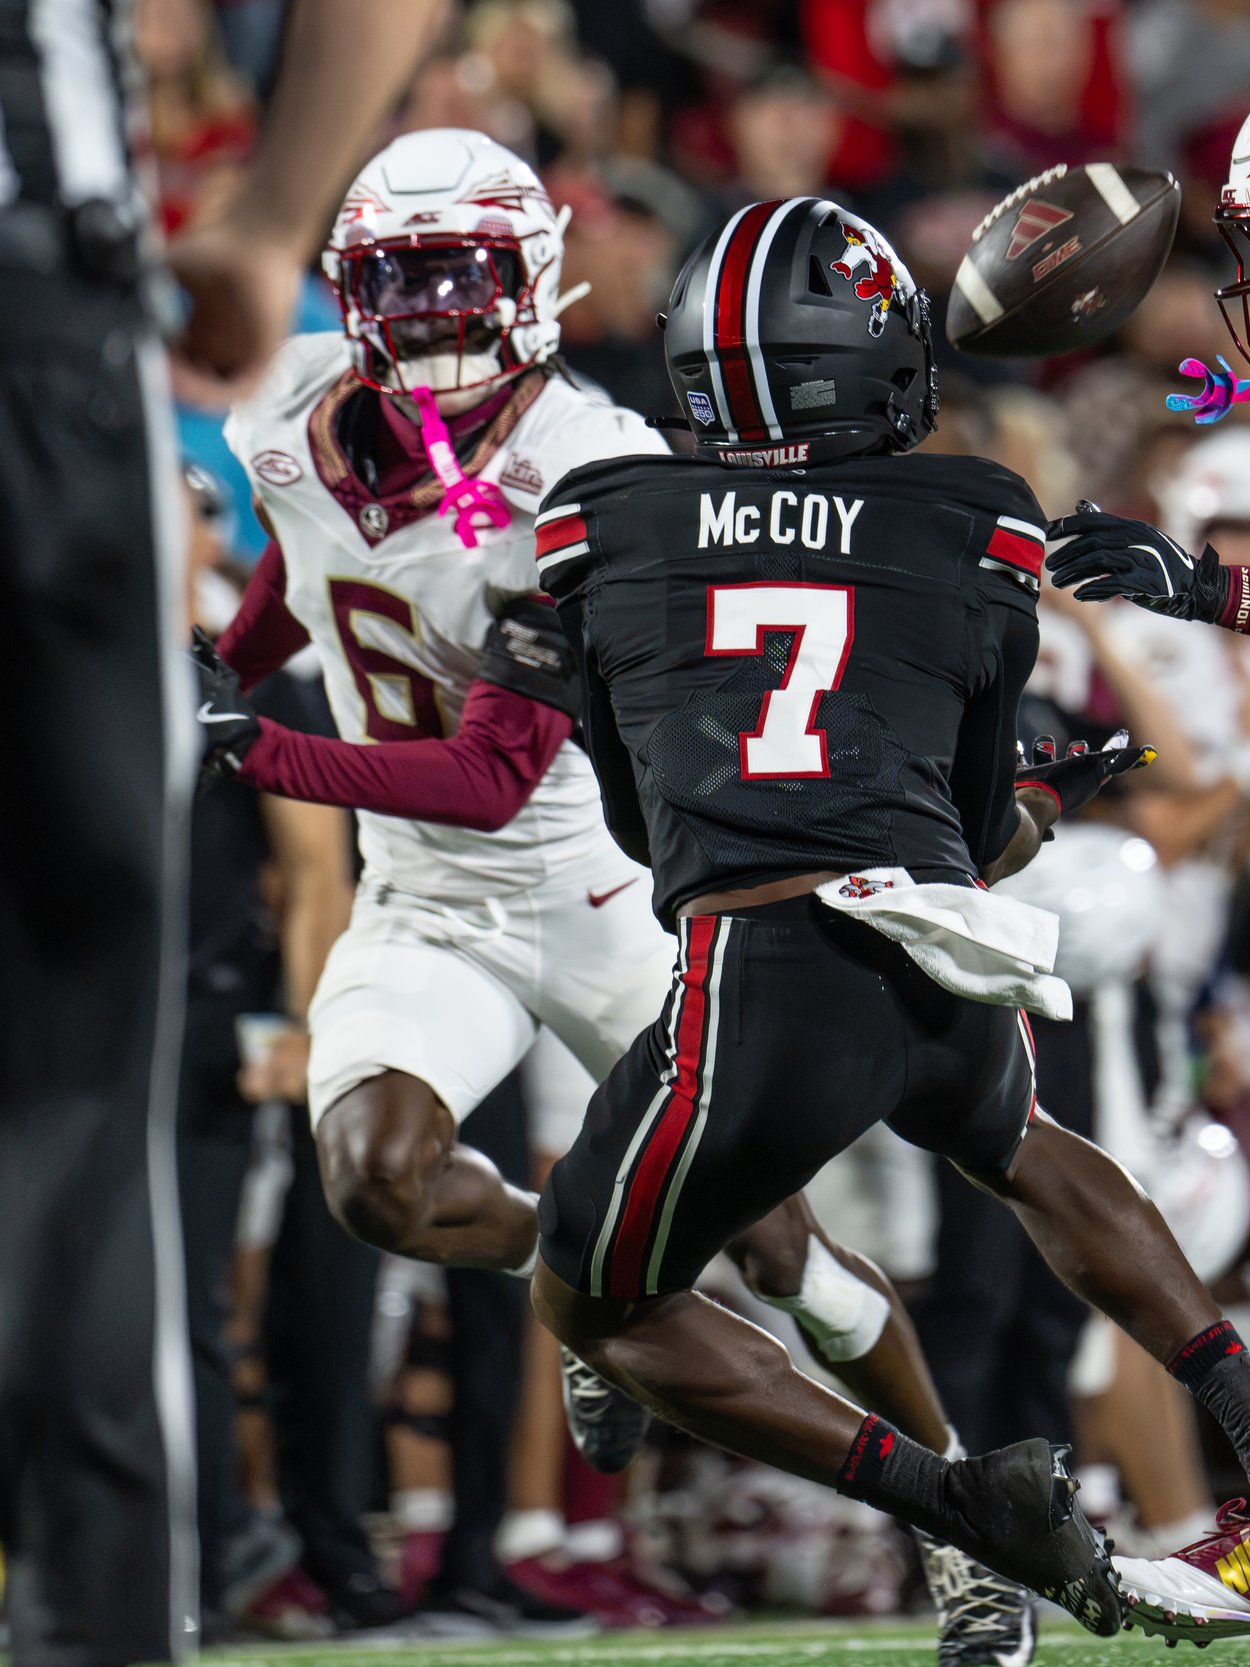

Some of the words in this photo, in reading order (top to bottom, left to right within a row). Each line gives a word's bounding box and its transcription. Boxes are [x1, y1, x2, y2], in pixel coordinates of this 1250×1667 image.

[689, 396, 708, 405] USA
[718, 442, 810, 470] LOUISVILLE
[697, 490, 865, 555] McCOY
[324, 574, 446, 744] 6
[703, 580, 855, 780] 7
